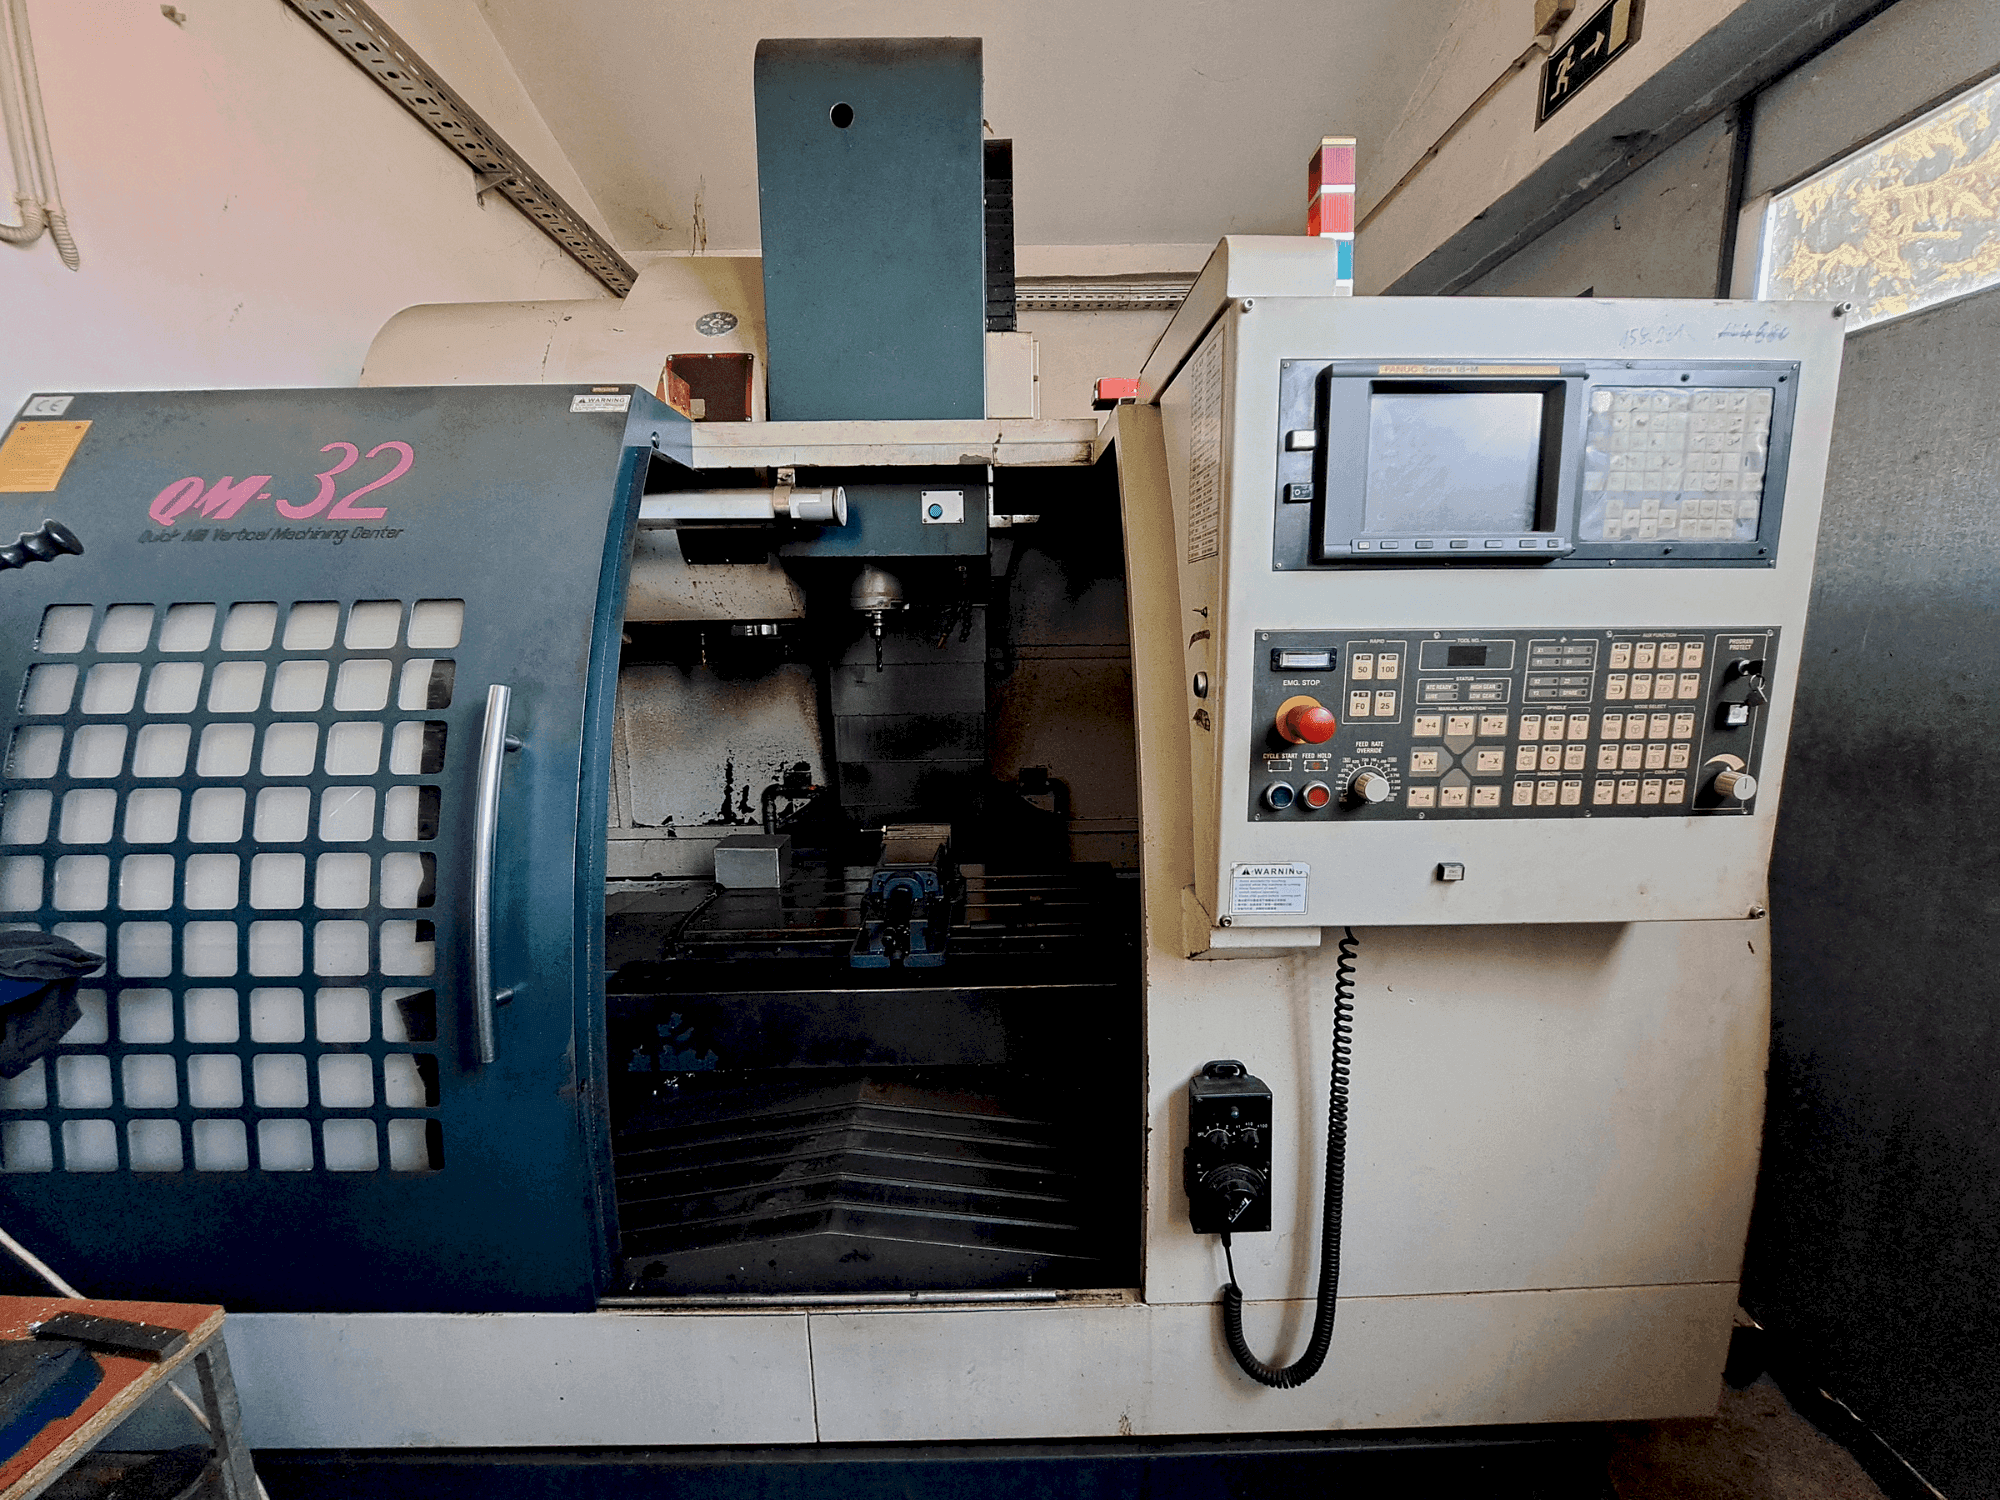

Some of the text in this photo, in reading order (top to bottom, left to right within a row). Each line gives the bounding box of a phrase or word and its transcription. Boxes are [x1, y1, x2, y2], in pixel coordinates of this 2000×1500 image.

[212, 527, 273, 541] Vertical
[271, 526, 350, 545] Machining
[350, 526, 404, 540] Center
